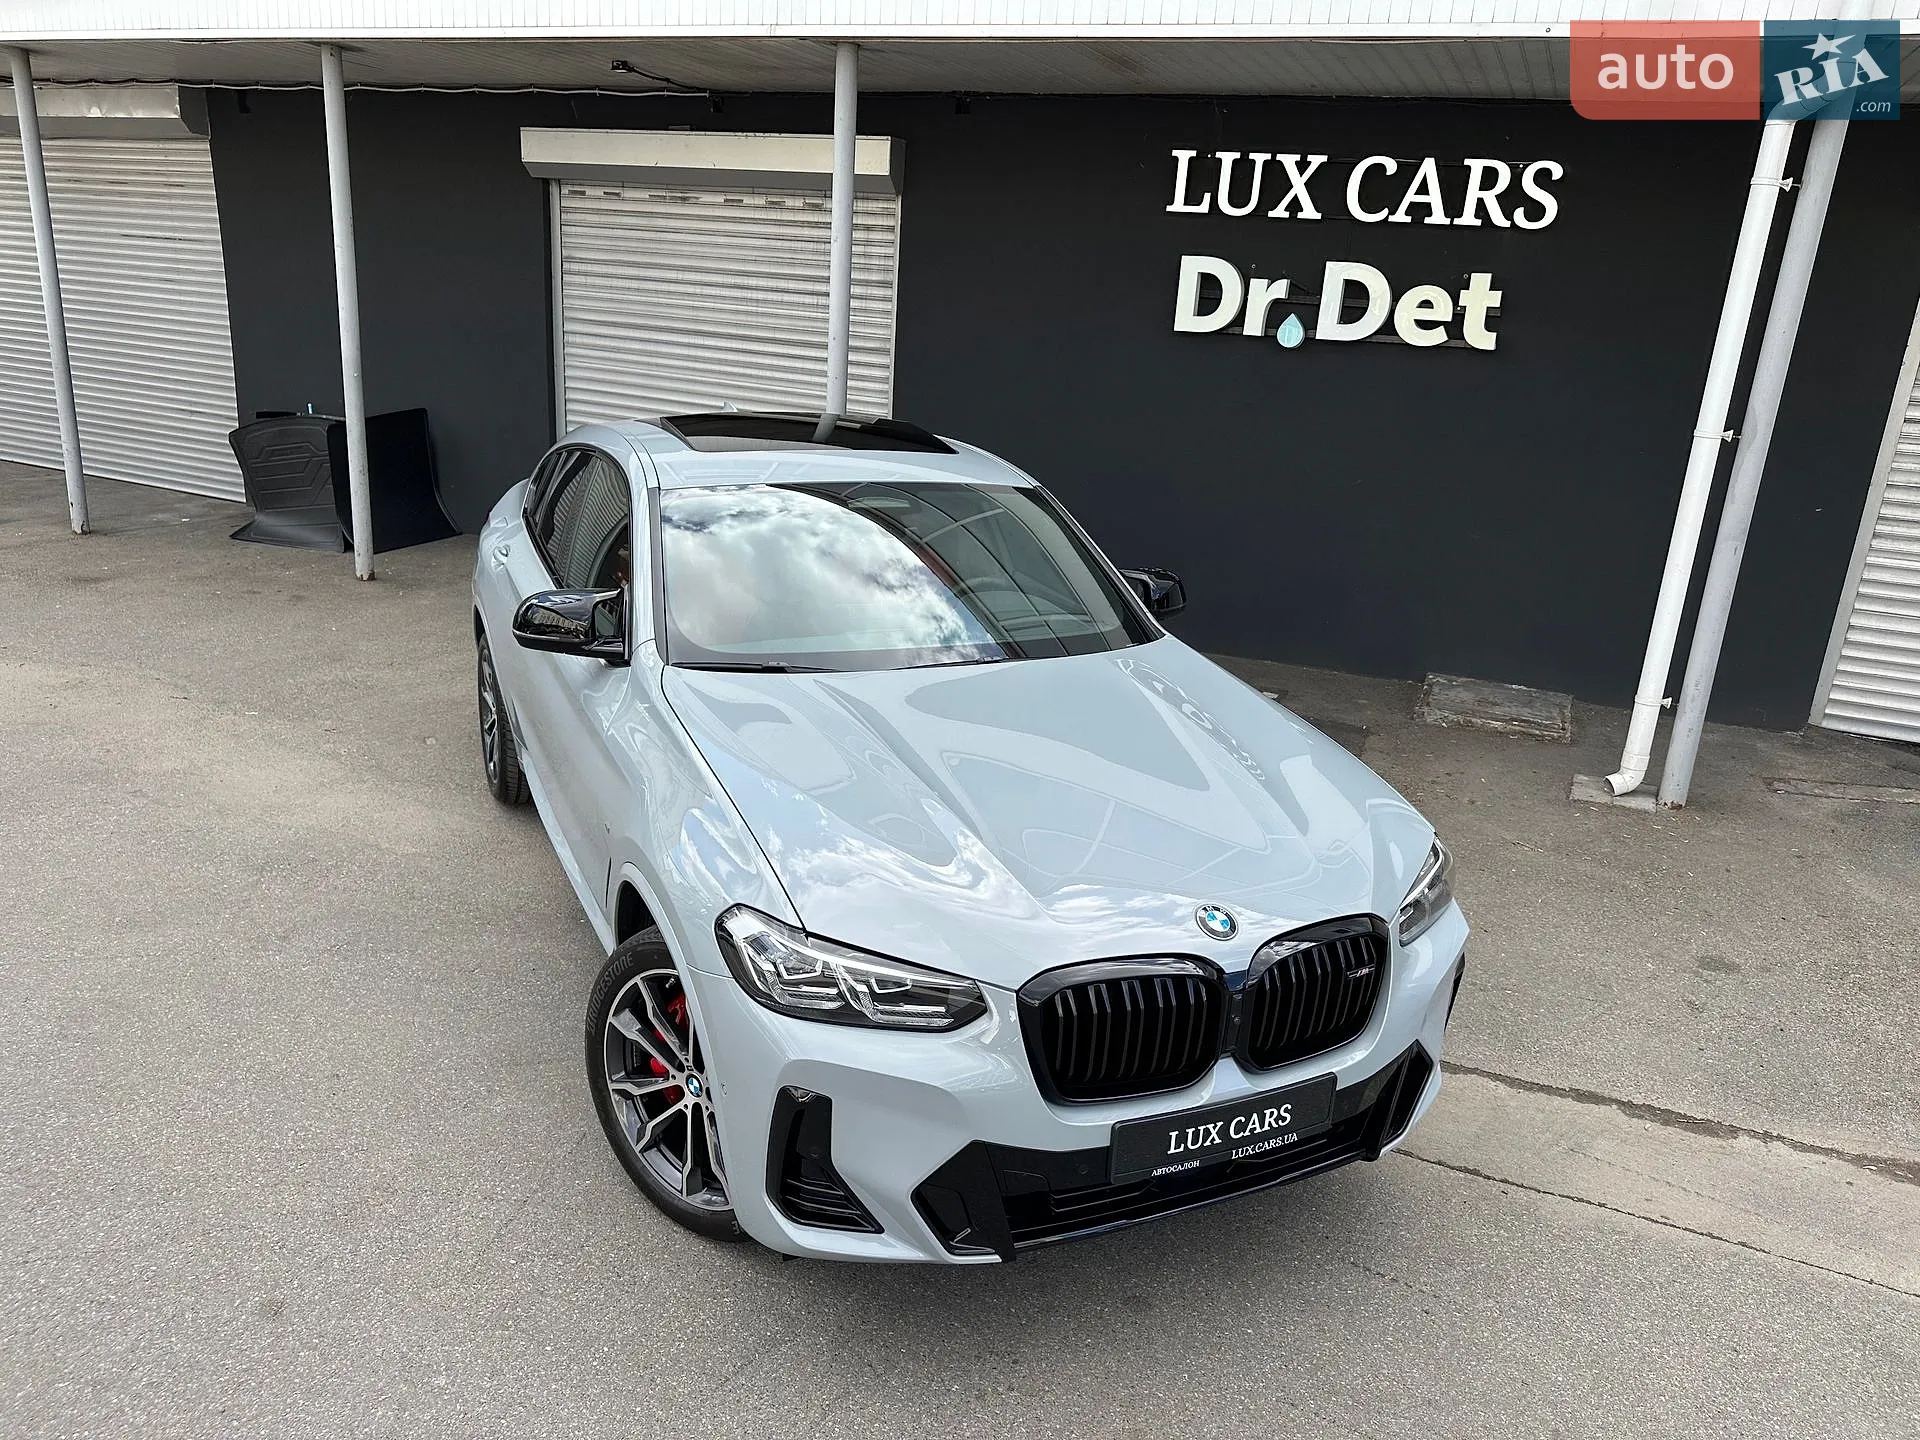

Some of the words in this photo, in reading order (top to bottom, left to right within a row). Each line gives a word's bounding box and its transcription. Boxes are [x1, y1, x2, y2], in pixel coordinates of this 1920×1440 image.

[1166, 149, 1329, 220] LUX
[1346, 155, 1564, 230] CARS
[1167, 1121, 1224, 1155] LUX
[1229, 1103, 1292, 1139] CARS
[1231, 1132, 1299, 1160] LUX.CARS.UA
[1151, 1159, 1201, 1177] АВТОСАЛОН
